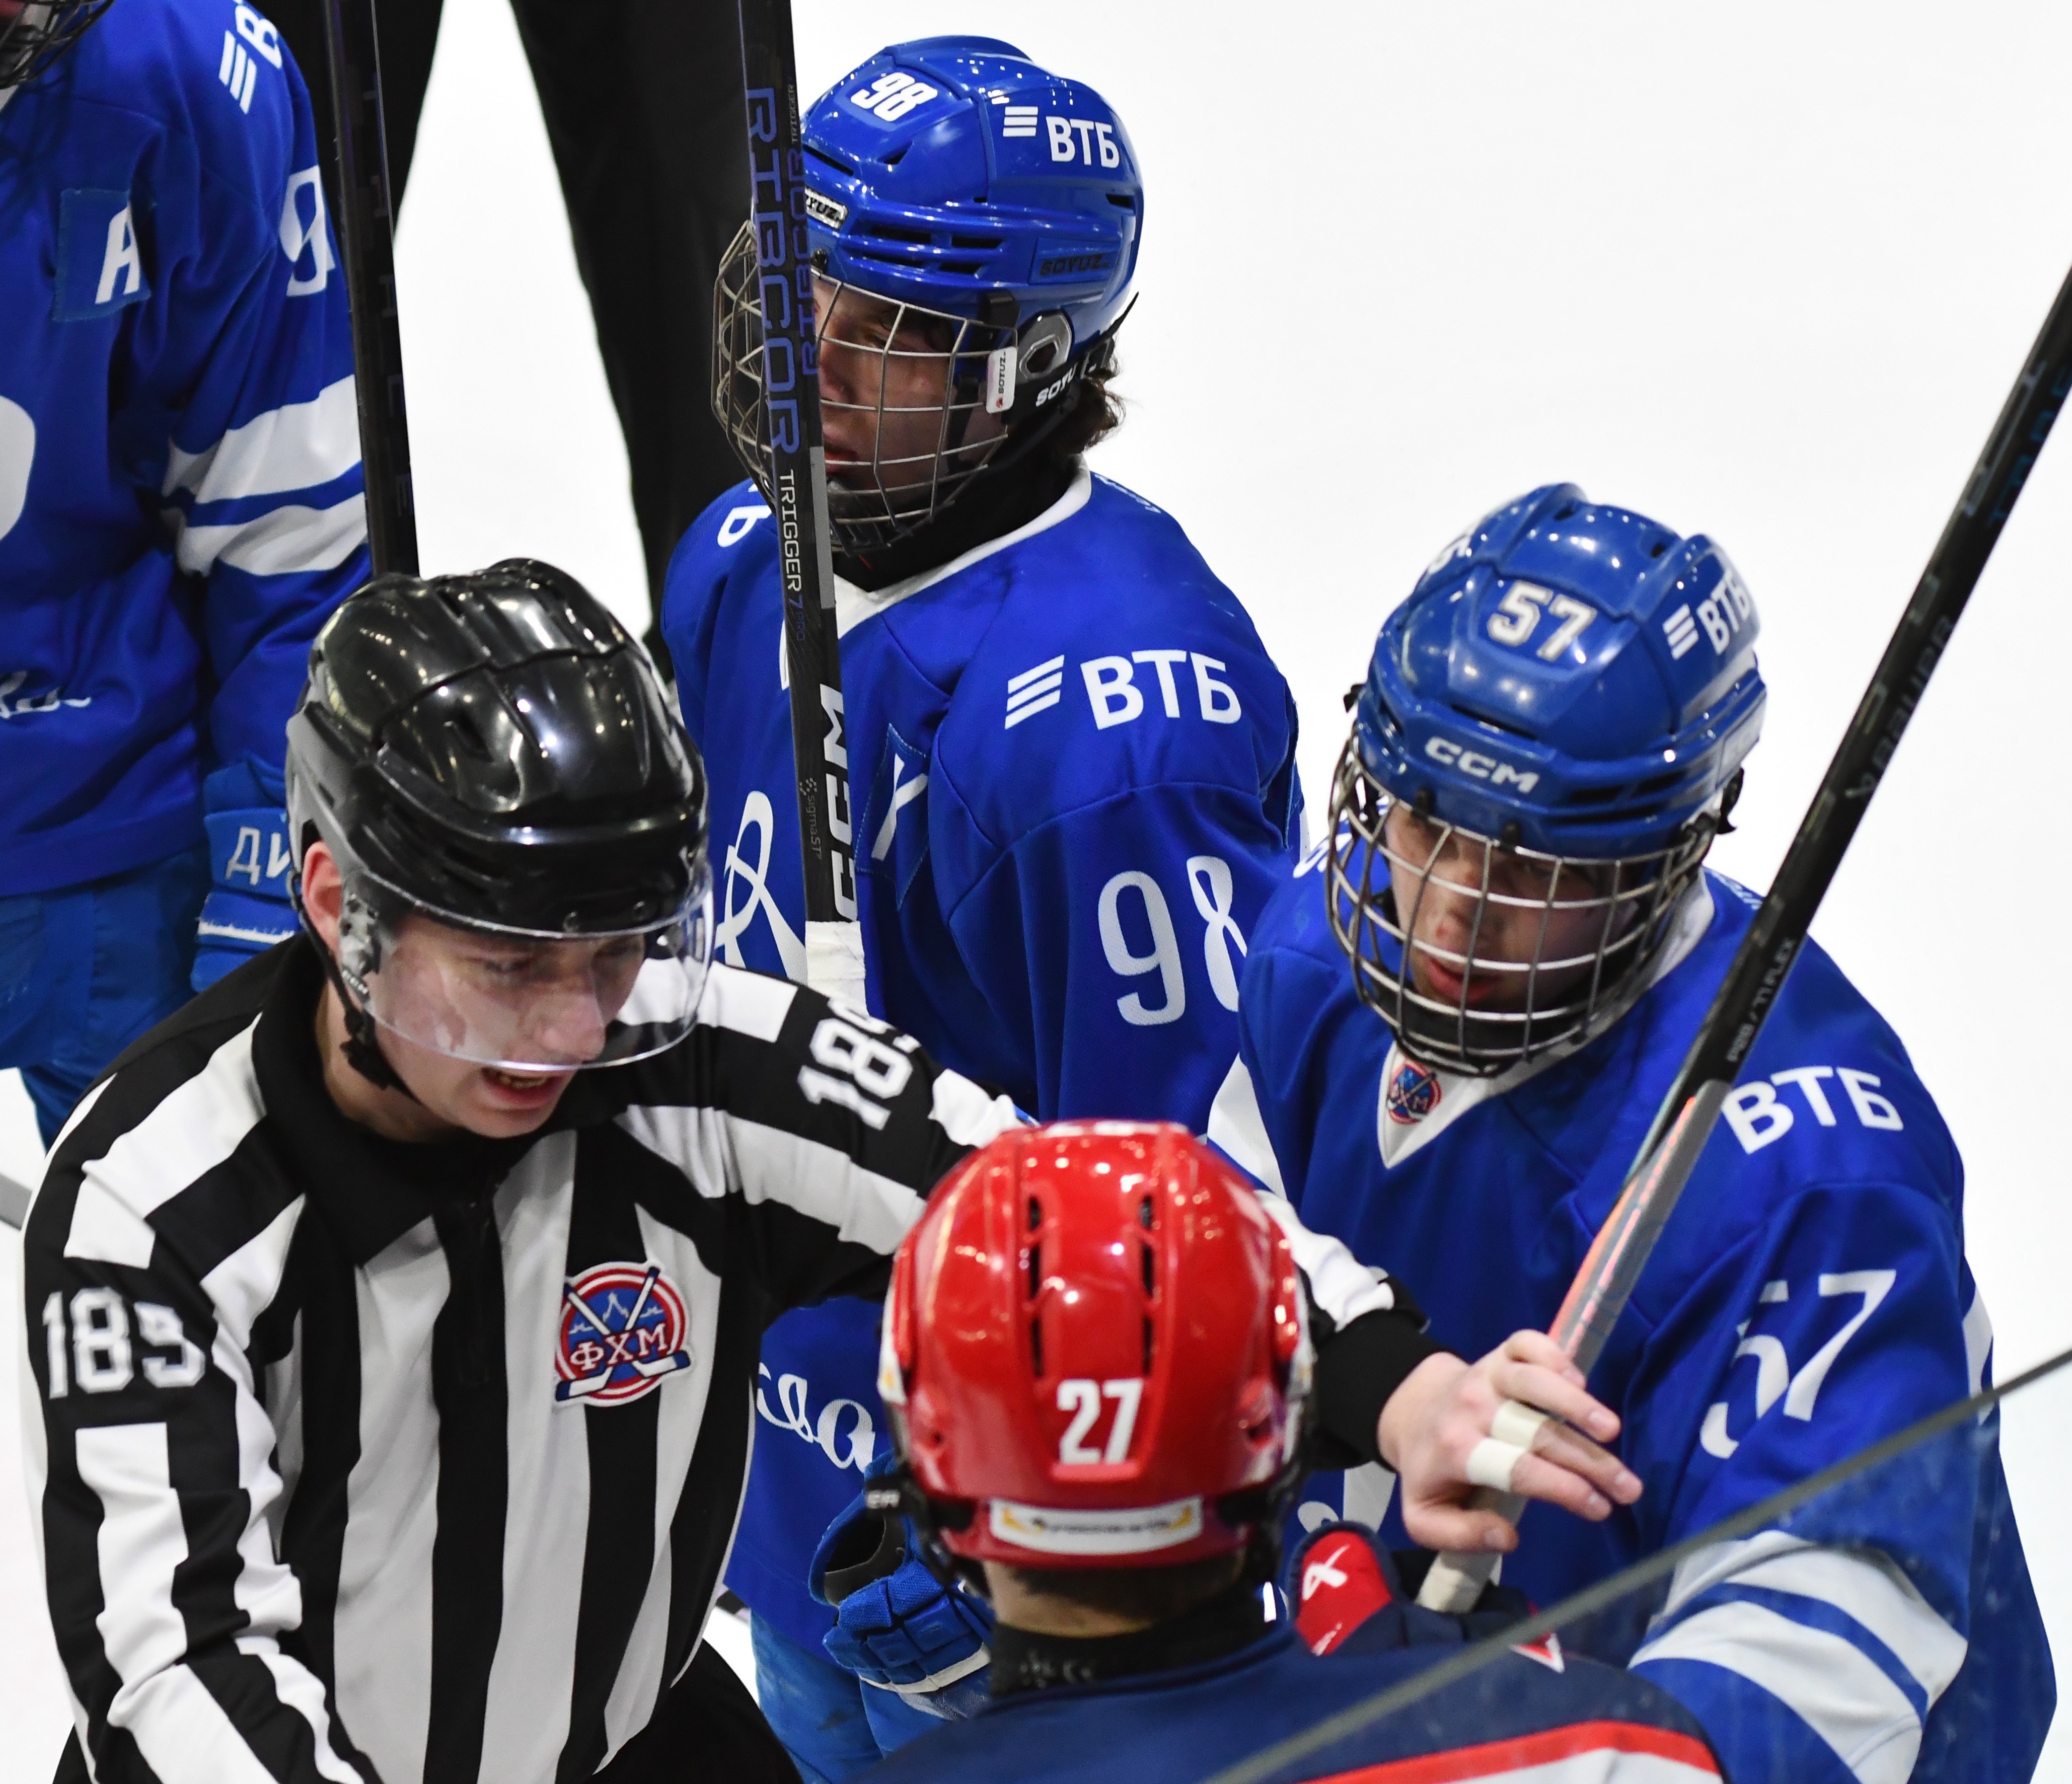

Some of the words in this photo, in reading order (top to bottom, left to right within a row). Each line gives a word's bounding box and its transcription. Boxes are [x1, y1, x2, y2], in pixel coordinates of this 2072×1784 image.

[851, 72, 937, 121] 98
[1048, 116, 1119, 168] ВТБ
[95, 203, 141, 304] А
[746, 88, 799, 454] RIBCOR
[780, 469, 801, 592] TRIGGER
[1487, 580, 1597, 661] 57
[1696, 576, 1754, 654] ВТБ
[1081, 649, 1242, 730] ВТБ
[820, 683, 858, 922] CCM
[1424, 736, 1539, 793] CCM
[1097, 855, 1247, 1026] 98
[1722, 1066, 1903, 1153] ВТБ
[570, 1322, 669, 1371] ФХМ
[1057, 1378, 1144, 1465] 27
